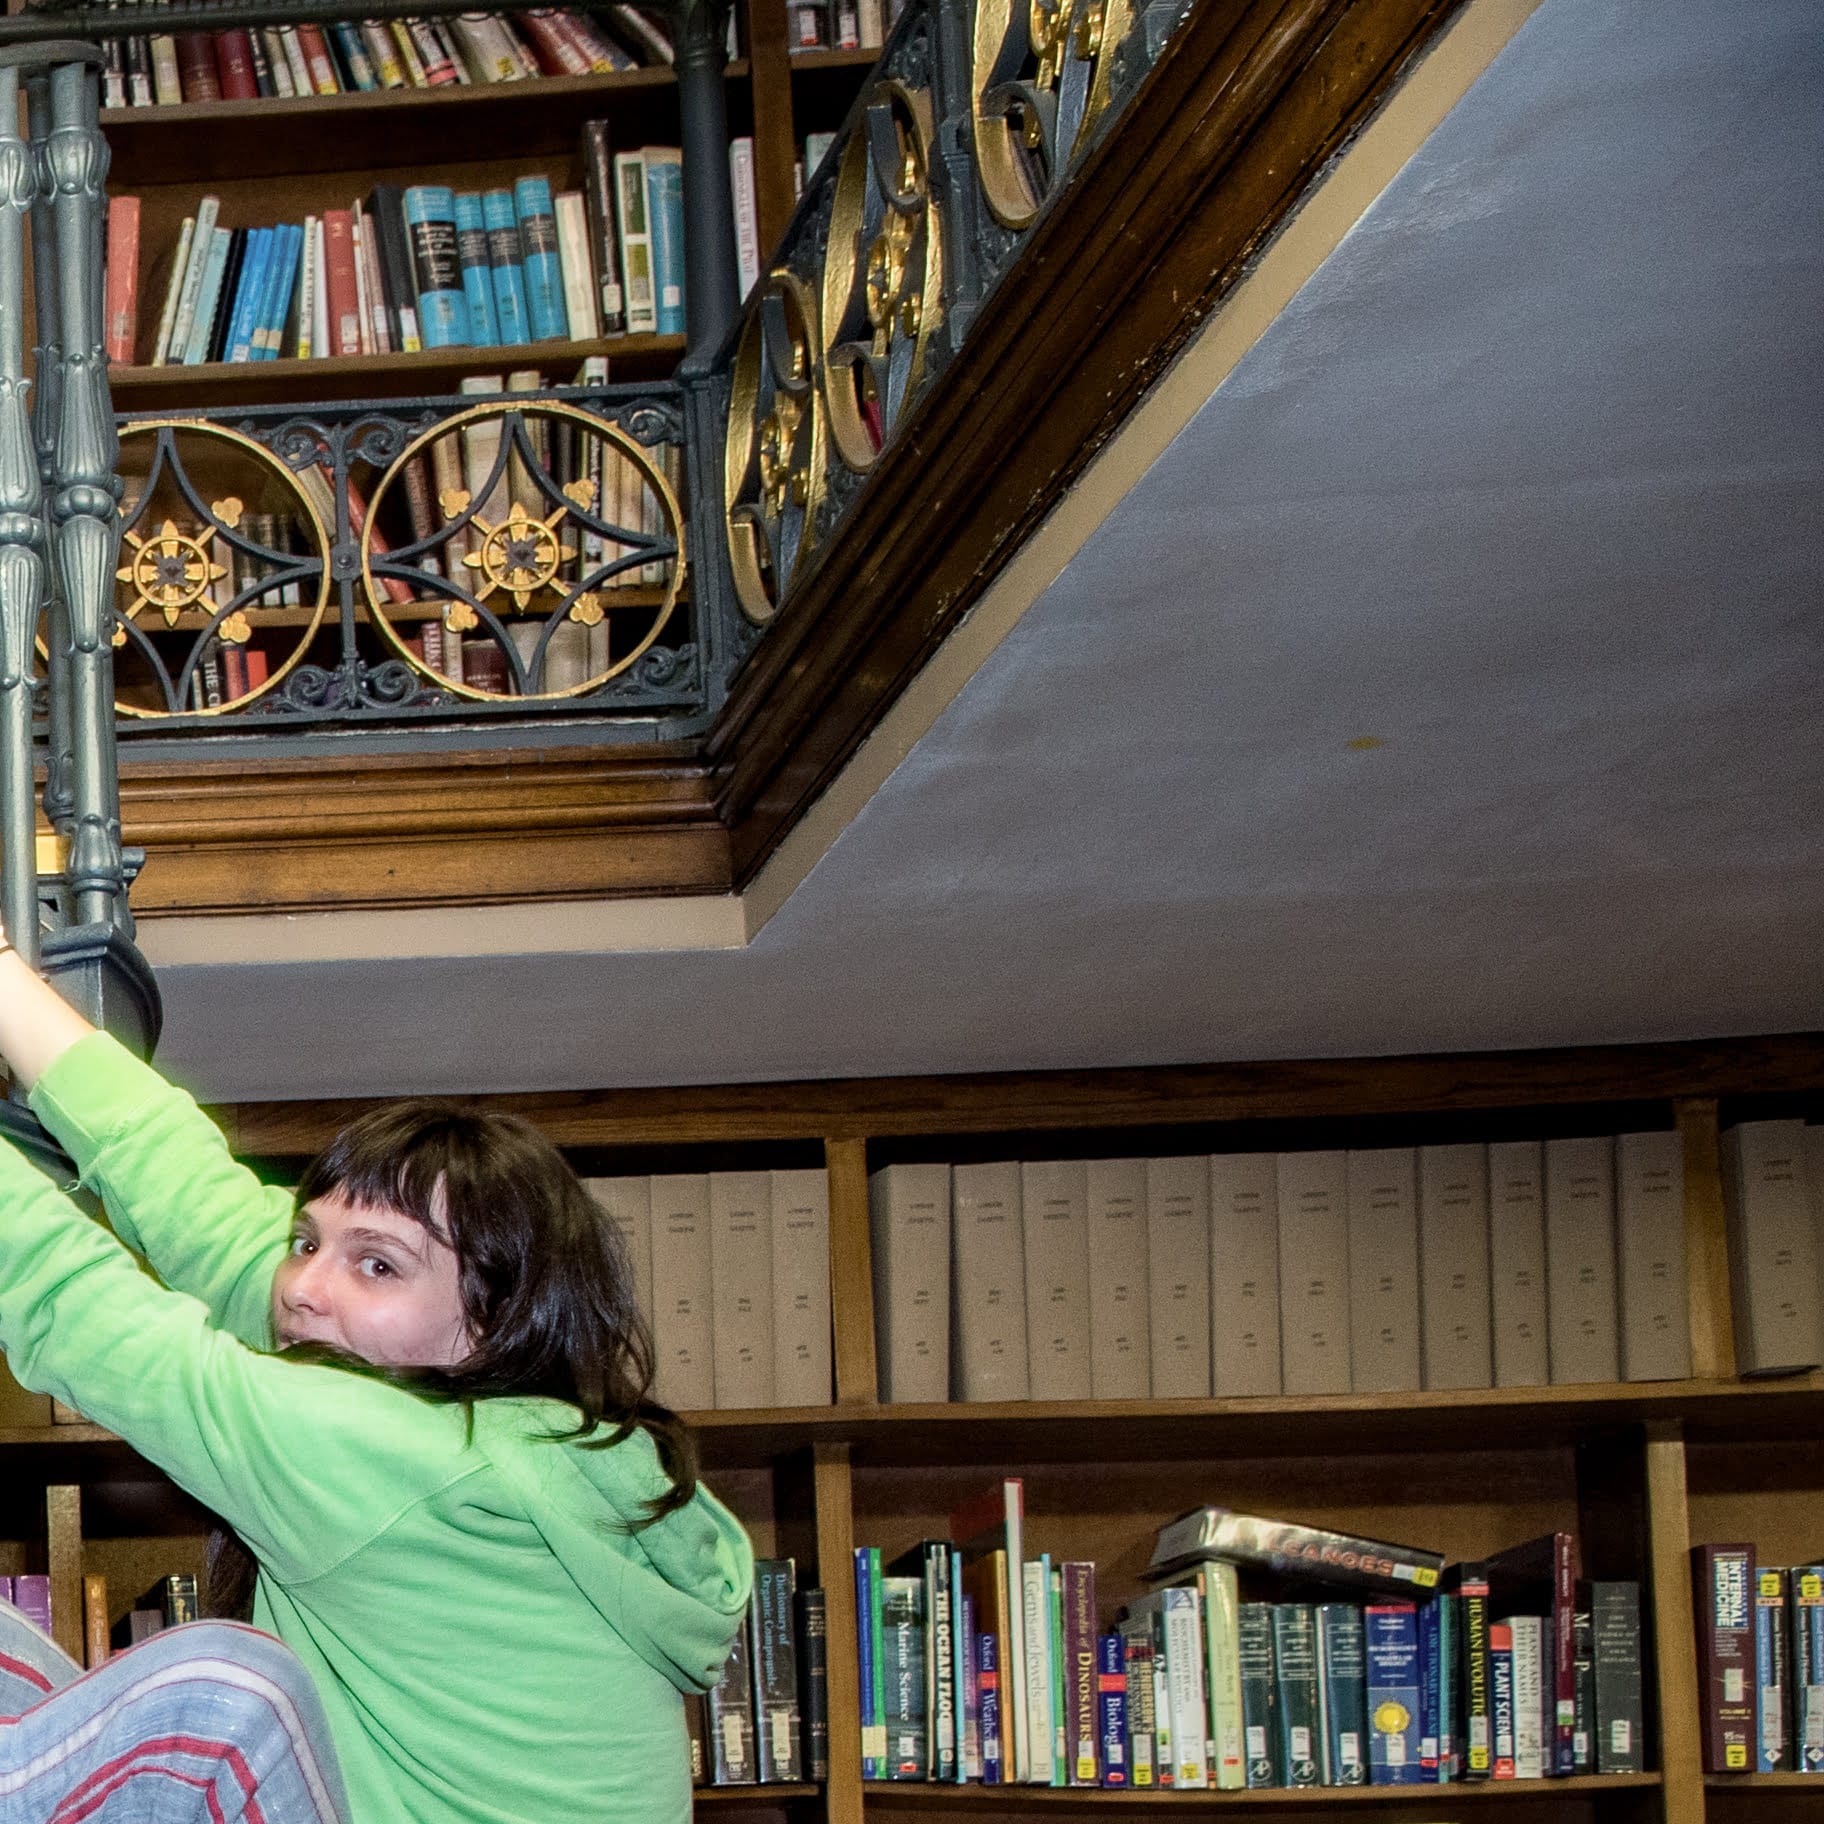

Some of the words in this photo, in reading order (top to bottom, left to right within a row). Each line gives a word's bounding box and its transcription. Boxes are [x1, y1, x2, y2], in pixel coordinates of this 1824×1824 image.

[204, 661, 219, 688] THE
[760, 1574, 772, 1618] Organic
[776, 1573, 789, 1631] Dictionary
[936, 1590, 951, 1623] THE
[1027, 1581, 1039, 1626] Gems
[1716, 1560, 1729, 1626] MEDICINE
[1731, 1560, 1744, 1626] INTERNAL
[779, 1634, 790, 1646] of
[898, 1621, 911, 1668] Marine
[1469, 1598, 1484, 1648] HUMAN
[1518, 1625, 1529, 1661] THEIR
[763, 1620, 777, 1686] Compounds
[937, 1625, 951, 1677] OCEAN
[982, 1635, 993, 1670] Oxford
[1106, 1638, 1118, 1673] Oxford
[1528, 1624, 1539, 1669] PLANTS
[899, 1671, 912, 1721] Science
[1077, 1652, 1094, 1742] DINOSAURS
[1495, 1662, 1512, 1699] PLANT
[1519, 1664, 1530, 1705] NAMES
[1530, 1671, 1540, 1697] AND
[1105, 1697, 1123, 1748] Biolog
[1496, 1701, 1512, 1736] SCIEN
